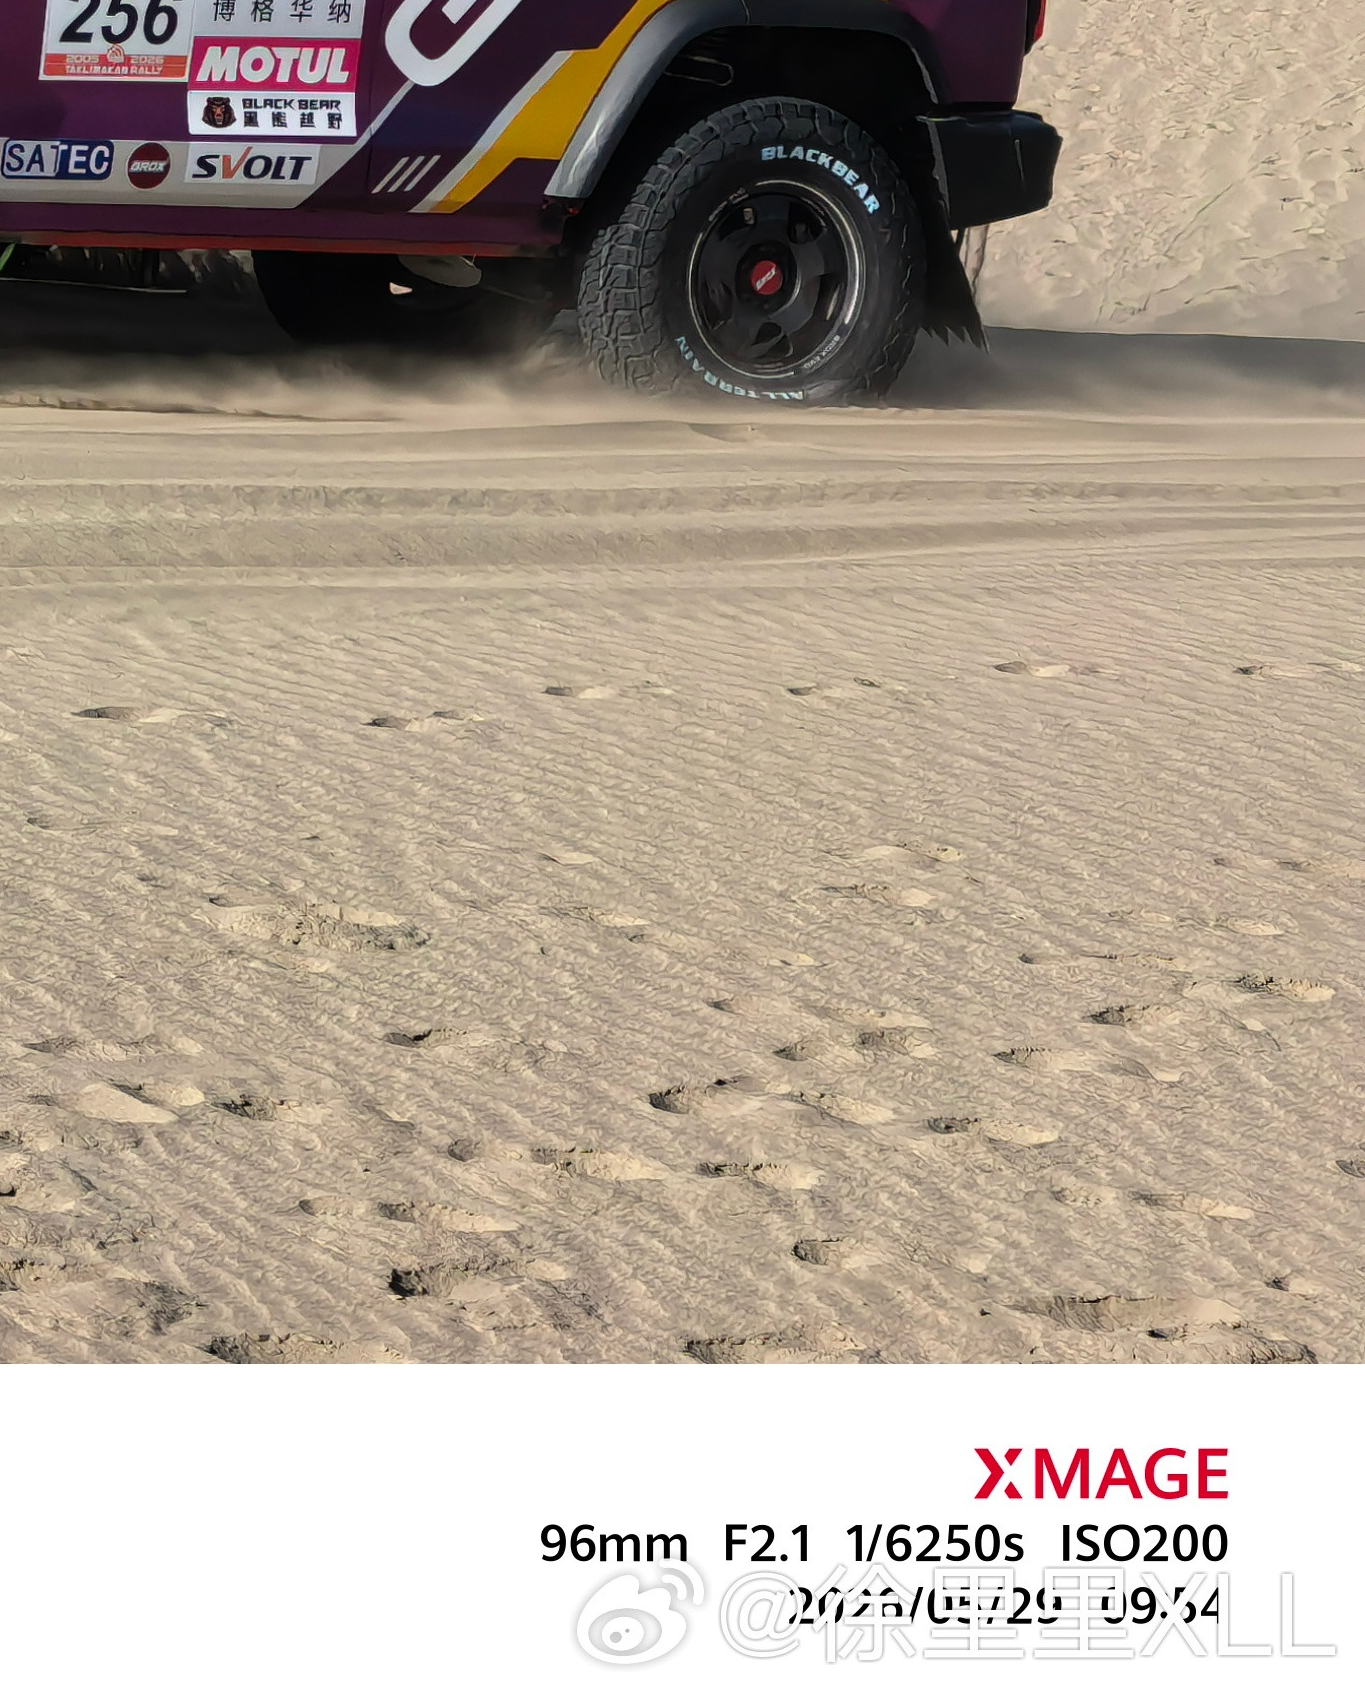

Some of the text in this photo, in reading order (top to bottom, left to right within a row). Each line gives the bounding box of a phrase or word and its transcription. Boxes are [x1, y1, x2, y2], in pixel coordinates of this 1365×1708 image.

[130, 65, 163, 75] RALLY
[195, 45, 351, 85] MOTUL
[242, 98, 342, 111] BLACK BEAR
[5, 143, 110, 175] SATEC
[191, 146, 313, 181] SVOLT
[761, 145, 881, 215] BLACKBEAR
